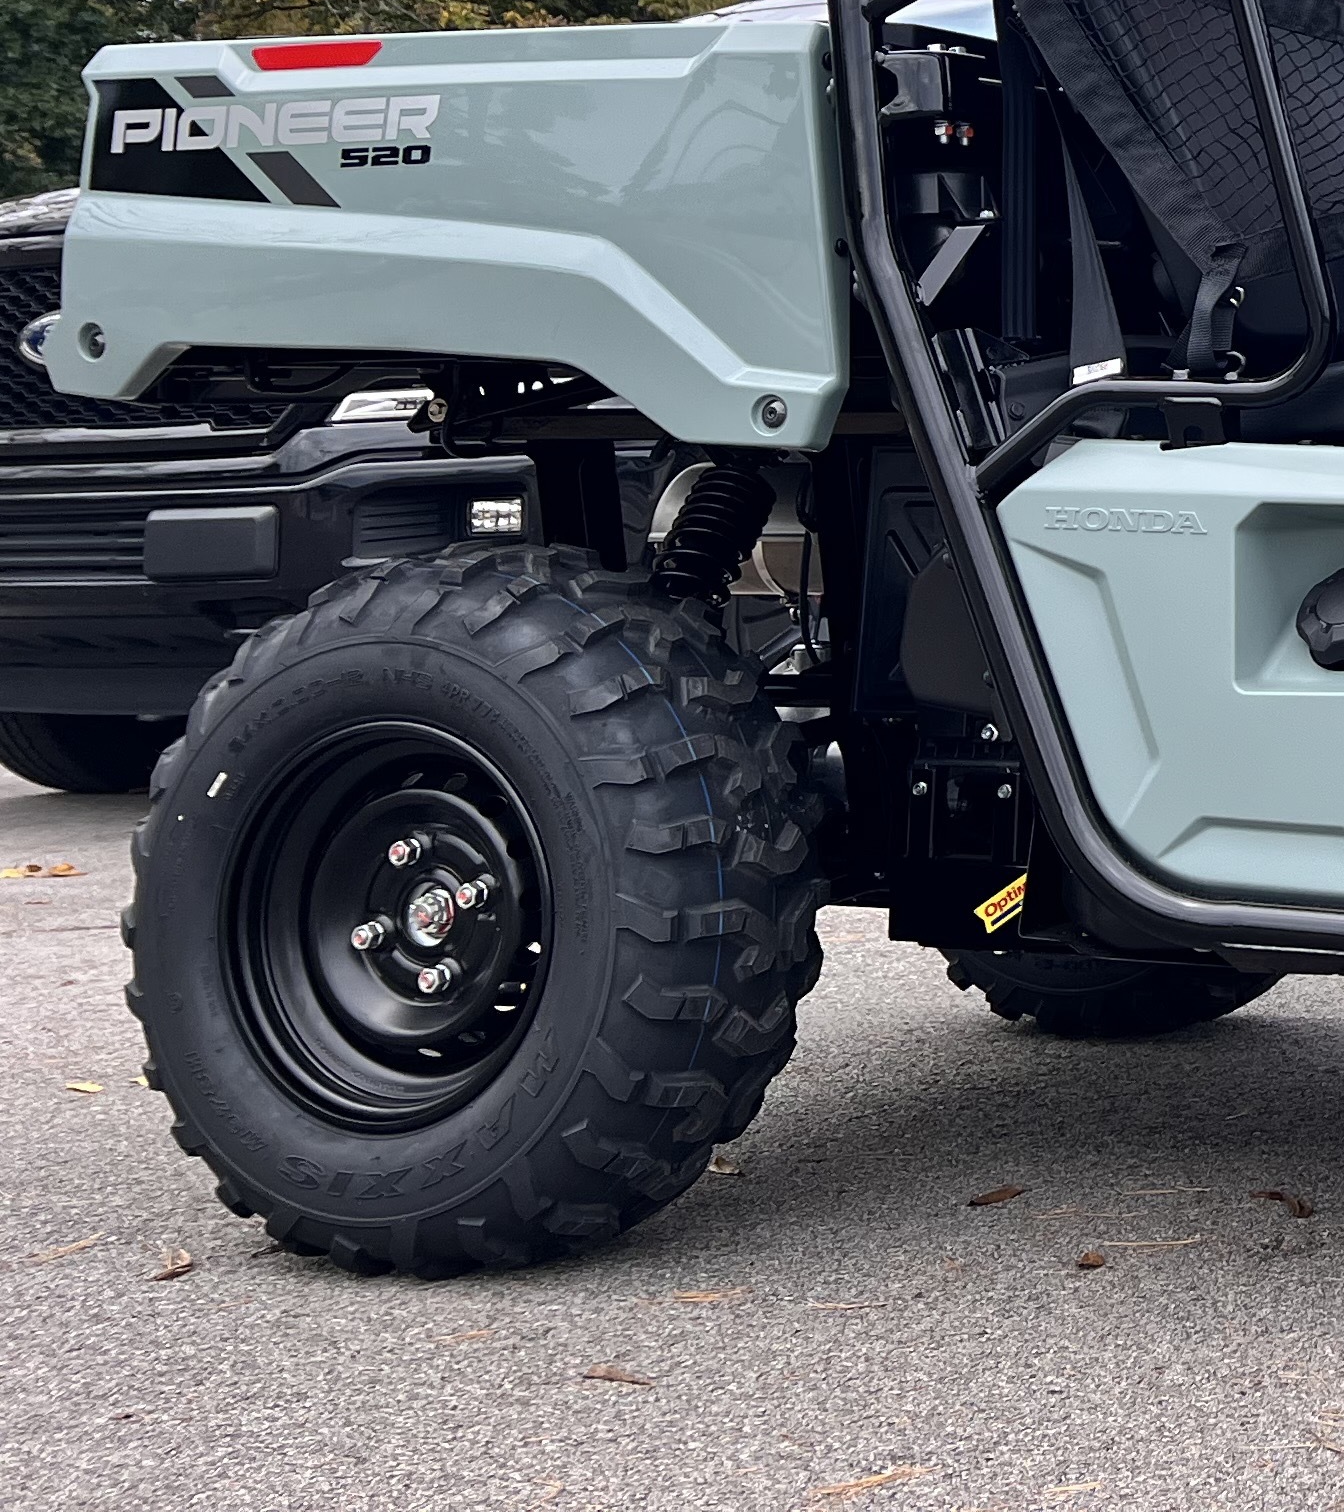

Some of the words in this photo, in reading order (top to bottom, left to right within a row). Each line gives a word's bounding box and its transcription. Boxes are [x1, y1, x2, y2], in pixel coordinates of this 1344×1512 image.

[110, 93, 441, 154] PIONEER
[340, 144, 432, 169] 520
[1044, 505, 1208, 535] HONDA
[276, 1022, 563, 1198] MAXXIS
